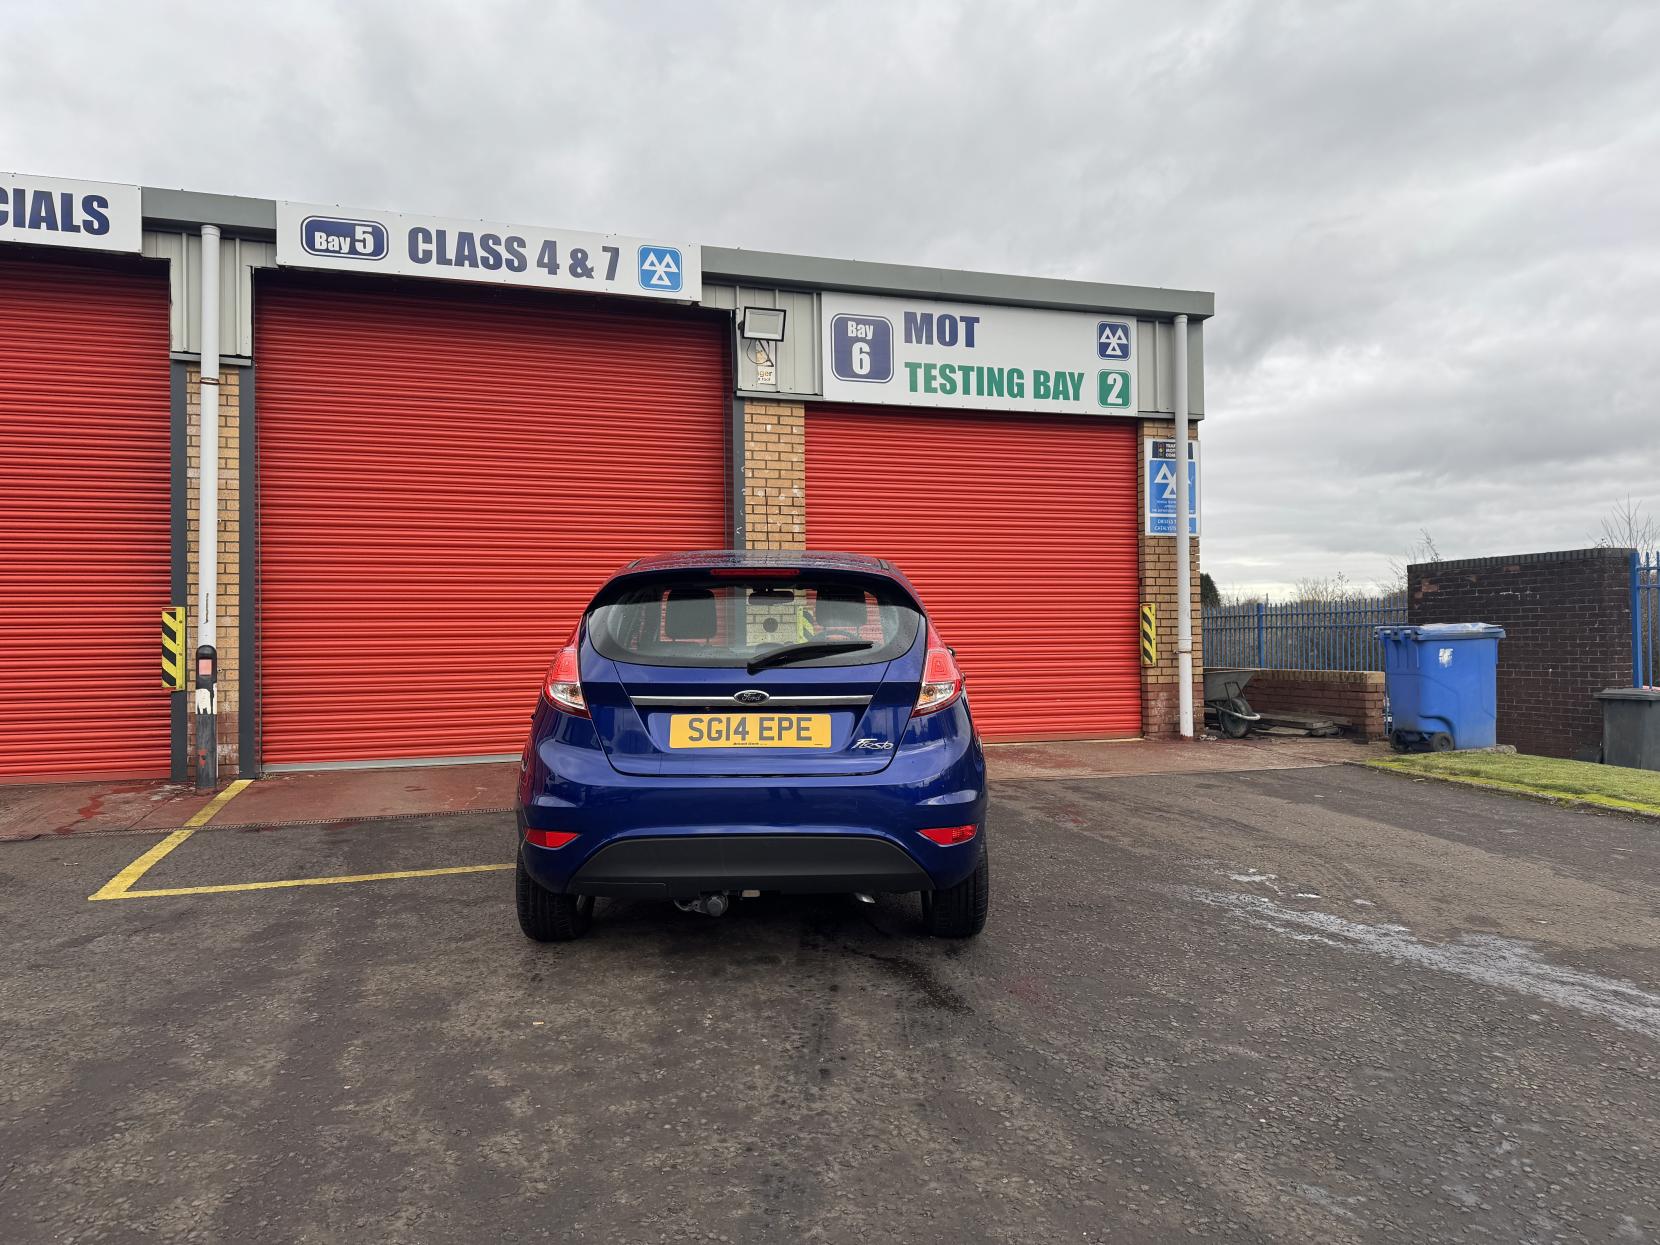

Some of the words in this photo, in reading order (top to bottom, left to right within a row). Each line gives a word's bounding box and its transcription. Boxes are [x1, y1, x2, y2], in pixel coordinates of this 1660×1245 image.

[314, 231, 351, 254] Bay
[355, 225, 375, 254] 5
[408, 226, 528, 273] CLASS
[536, 239, 560, 275] 4
[568, 247, 595, 279] &
[601, 245, 620, 281] 7
[847, 320, 874, 340] Bay
[903, 311, 981, 348] MOT
[851, 341, 871, 375] 6
[904, 361, 1025, 399] TESTING
[1033, 369, 1085, 401] BAY
[1107, 372, 1123, 405] 2
[688, 717, 749, 742] SG14
[758, 717, 813, 742] EPE
